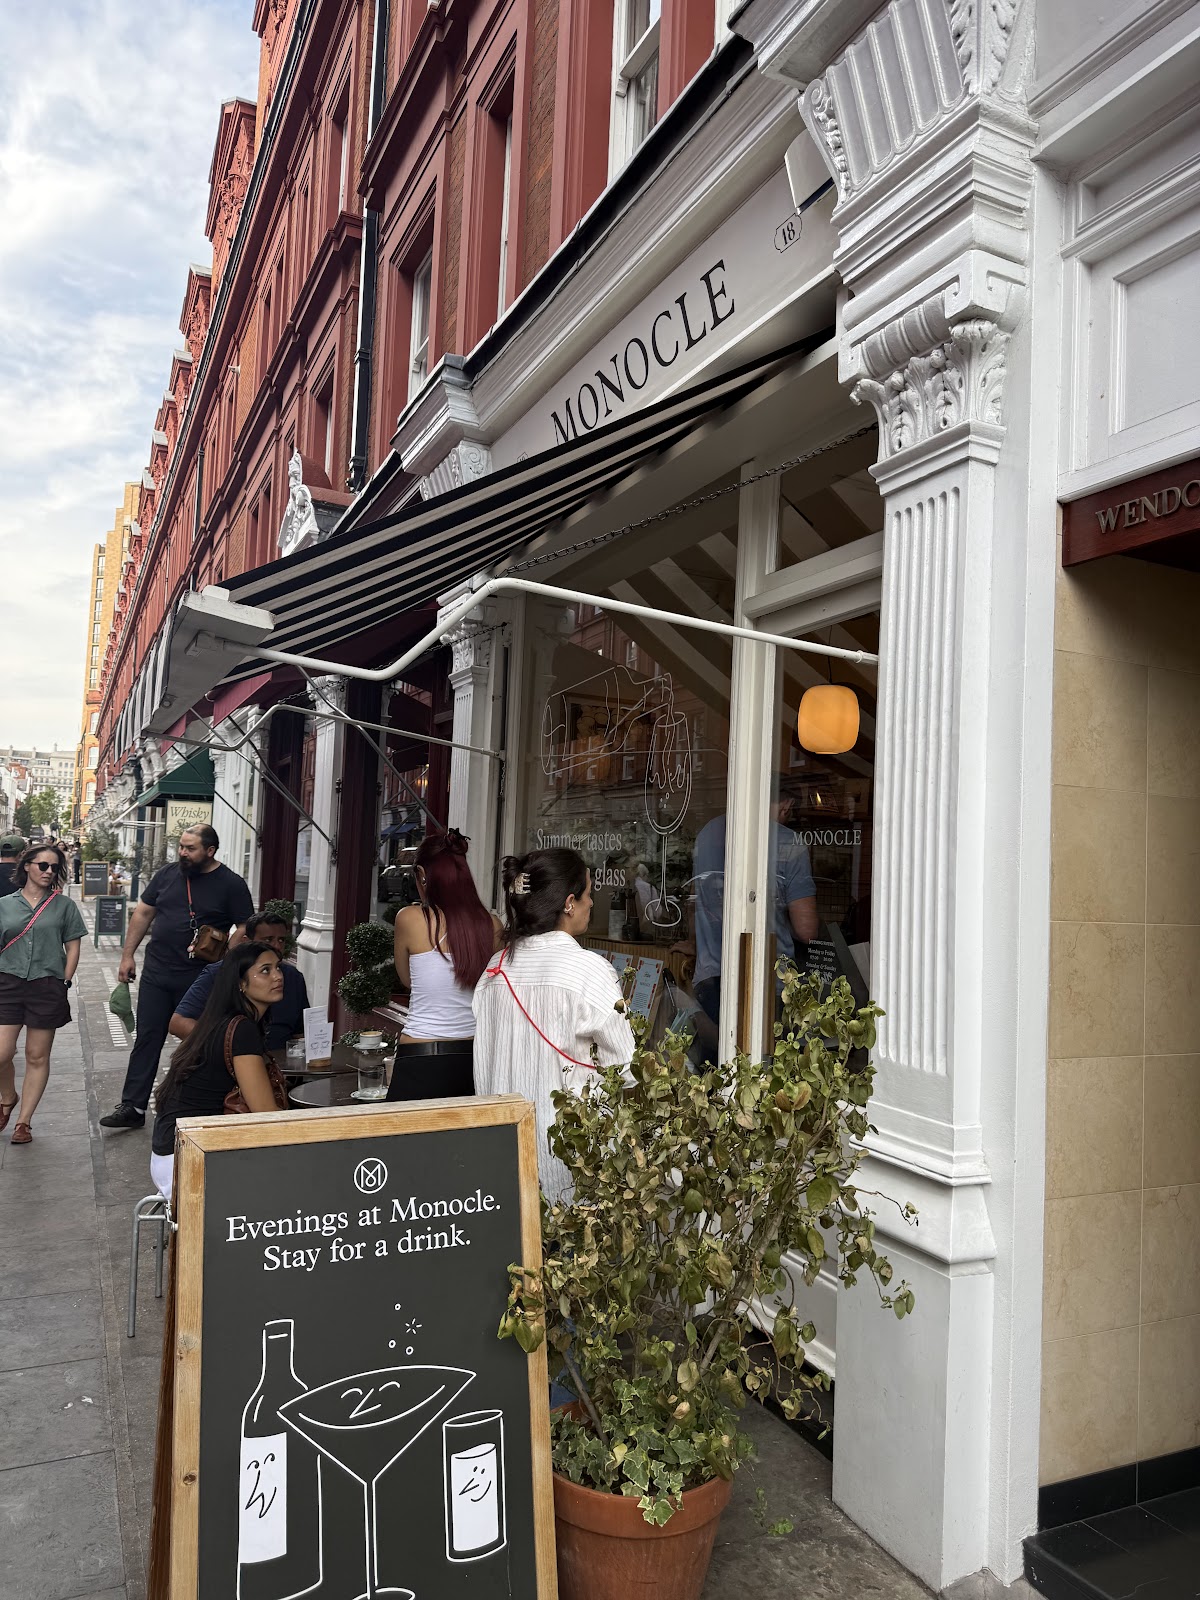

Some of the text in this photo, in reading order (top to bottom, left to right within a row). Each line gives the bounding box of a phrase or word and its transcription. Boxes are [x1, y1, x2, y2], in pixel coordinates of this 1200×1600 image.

[782, 221, 796, 246] 18
[550, 259, 735, 446] MONOCLE
[170, 806, 210, 823] Whisky
[536, 828, 622, 851] Summer tastes
[792, 829, 862, 846] MONOCLE
[594, 860, 626, 891] glass
[225, 1189, 501, 1242] Evenings at Monocle.
[263, 1224, 471, 1272] Stay for a drink.
